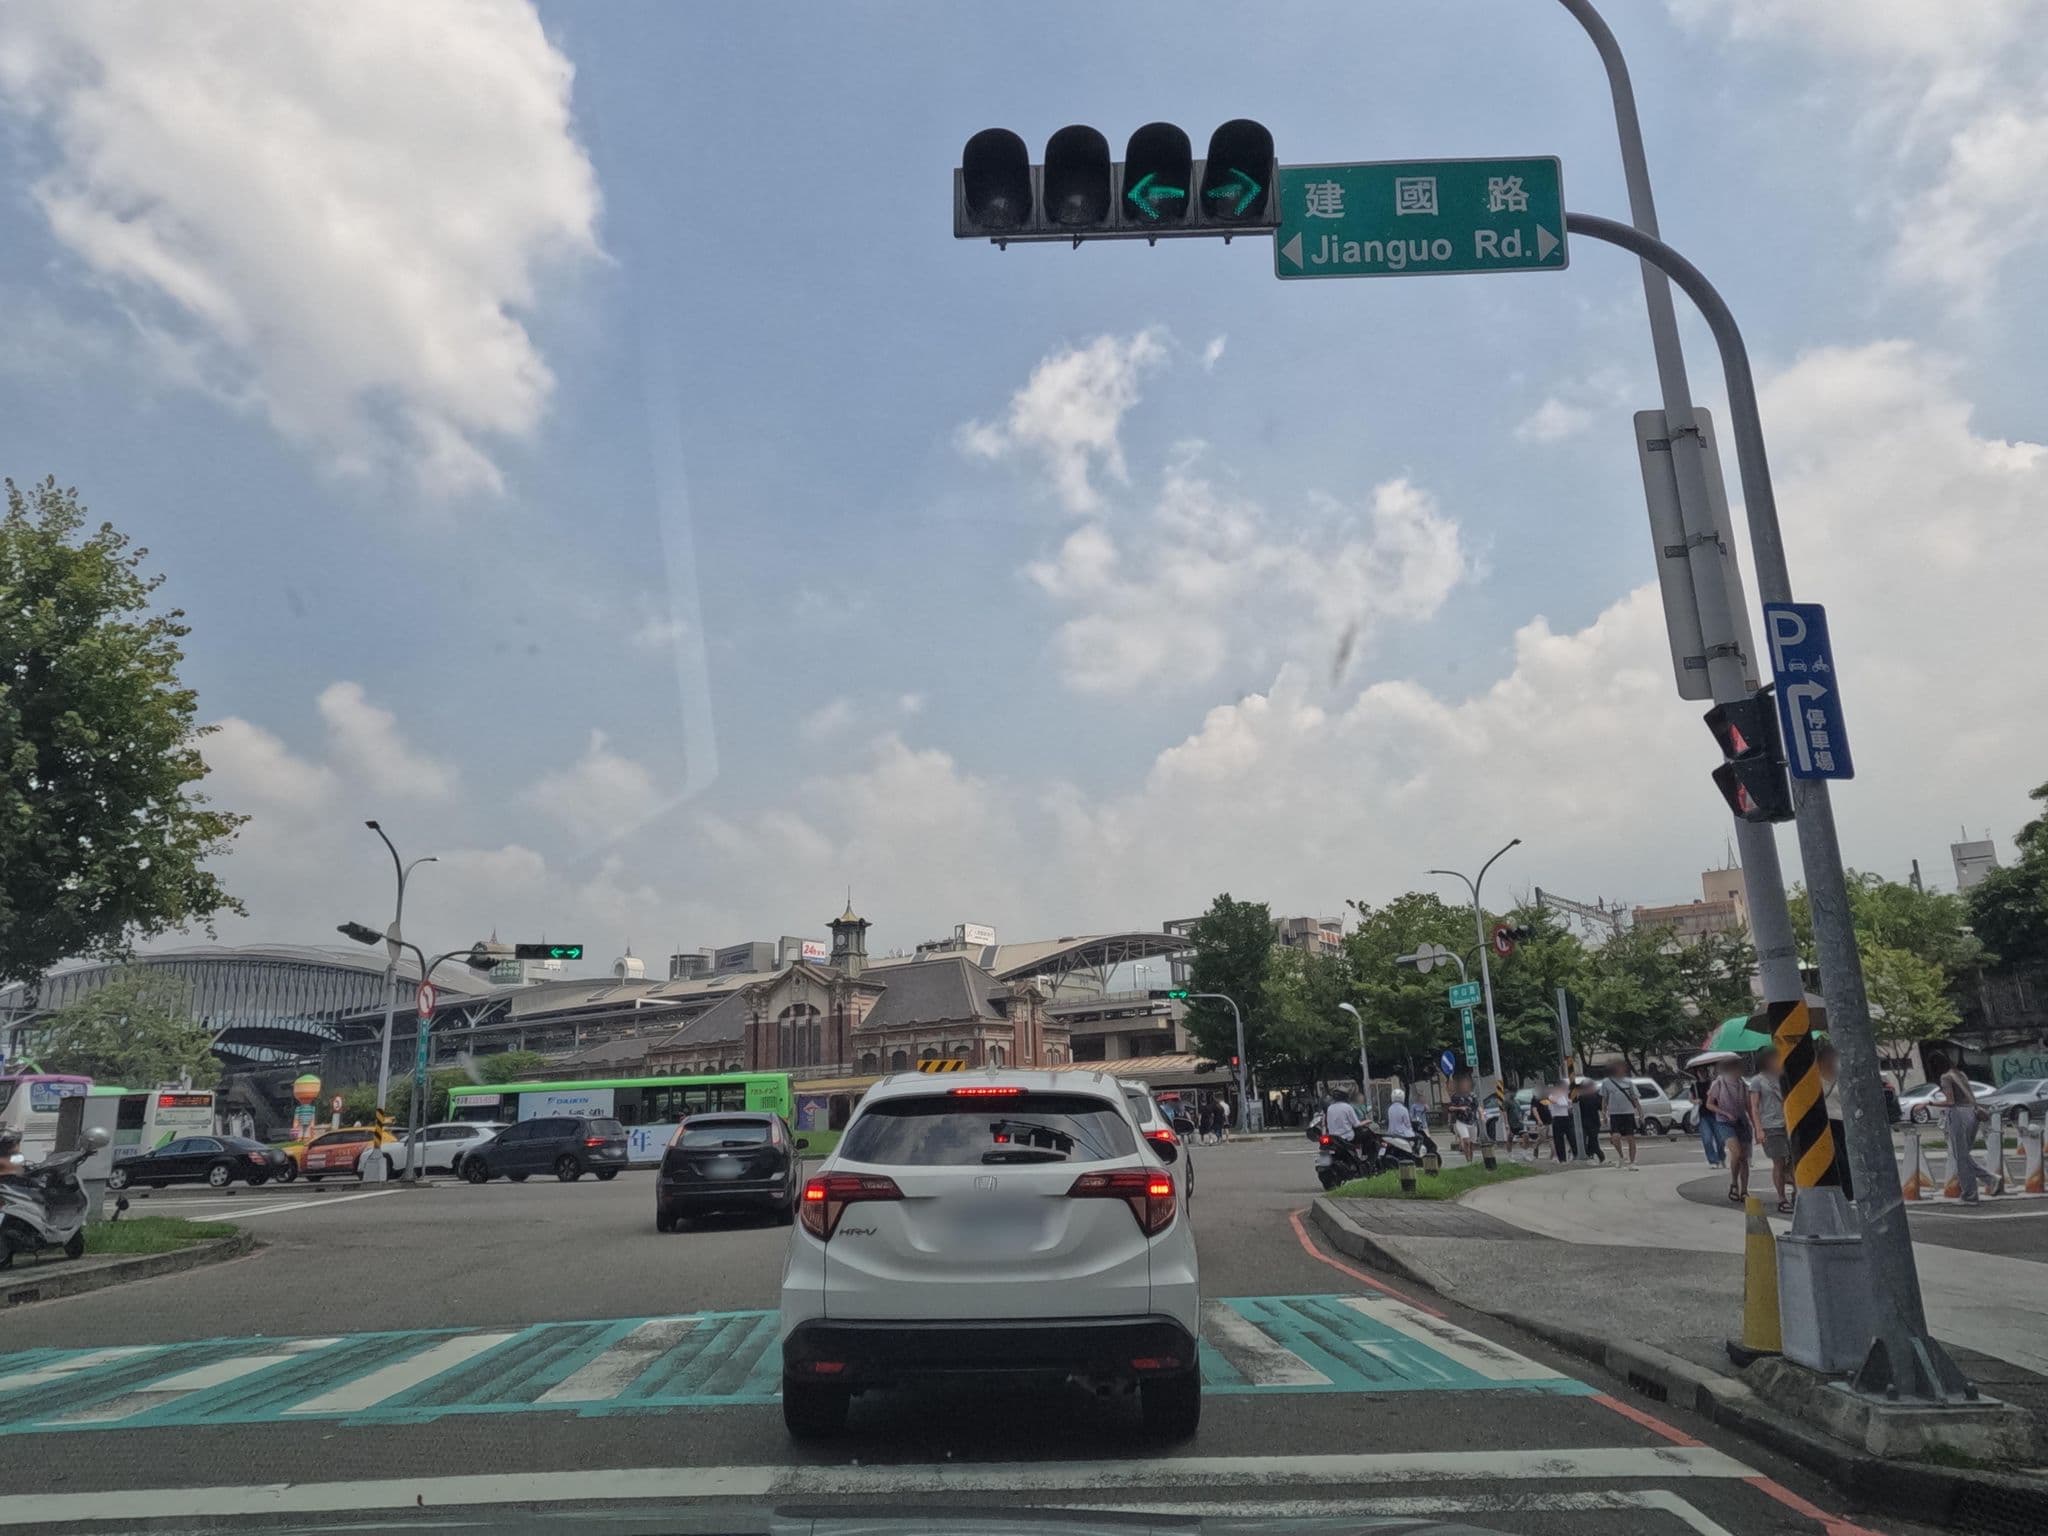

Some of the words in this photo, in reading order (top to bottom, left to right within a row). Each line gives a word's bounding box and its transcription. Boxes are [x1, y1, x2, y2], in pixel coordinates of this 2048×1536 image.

[1304, 175, 1529, 219] 建國路
[1311, 235, 1453, 269] Jianguo
[1474, 228, 1532, 259] Rd.
[1767, 610, 1807, 672] P
[838, 1227, 878, 1237] HR-V
